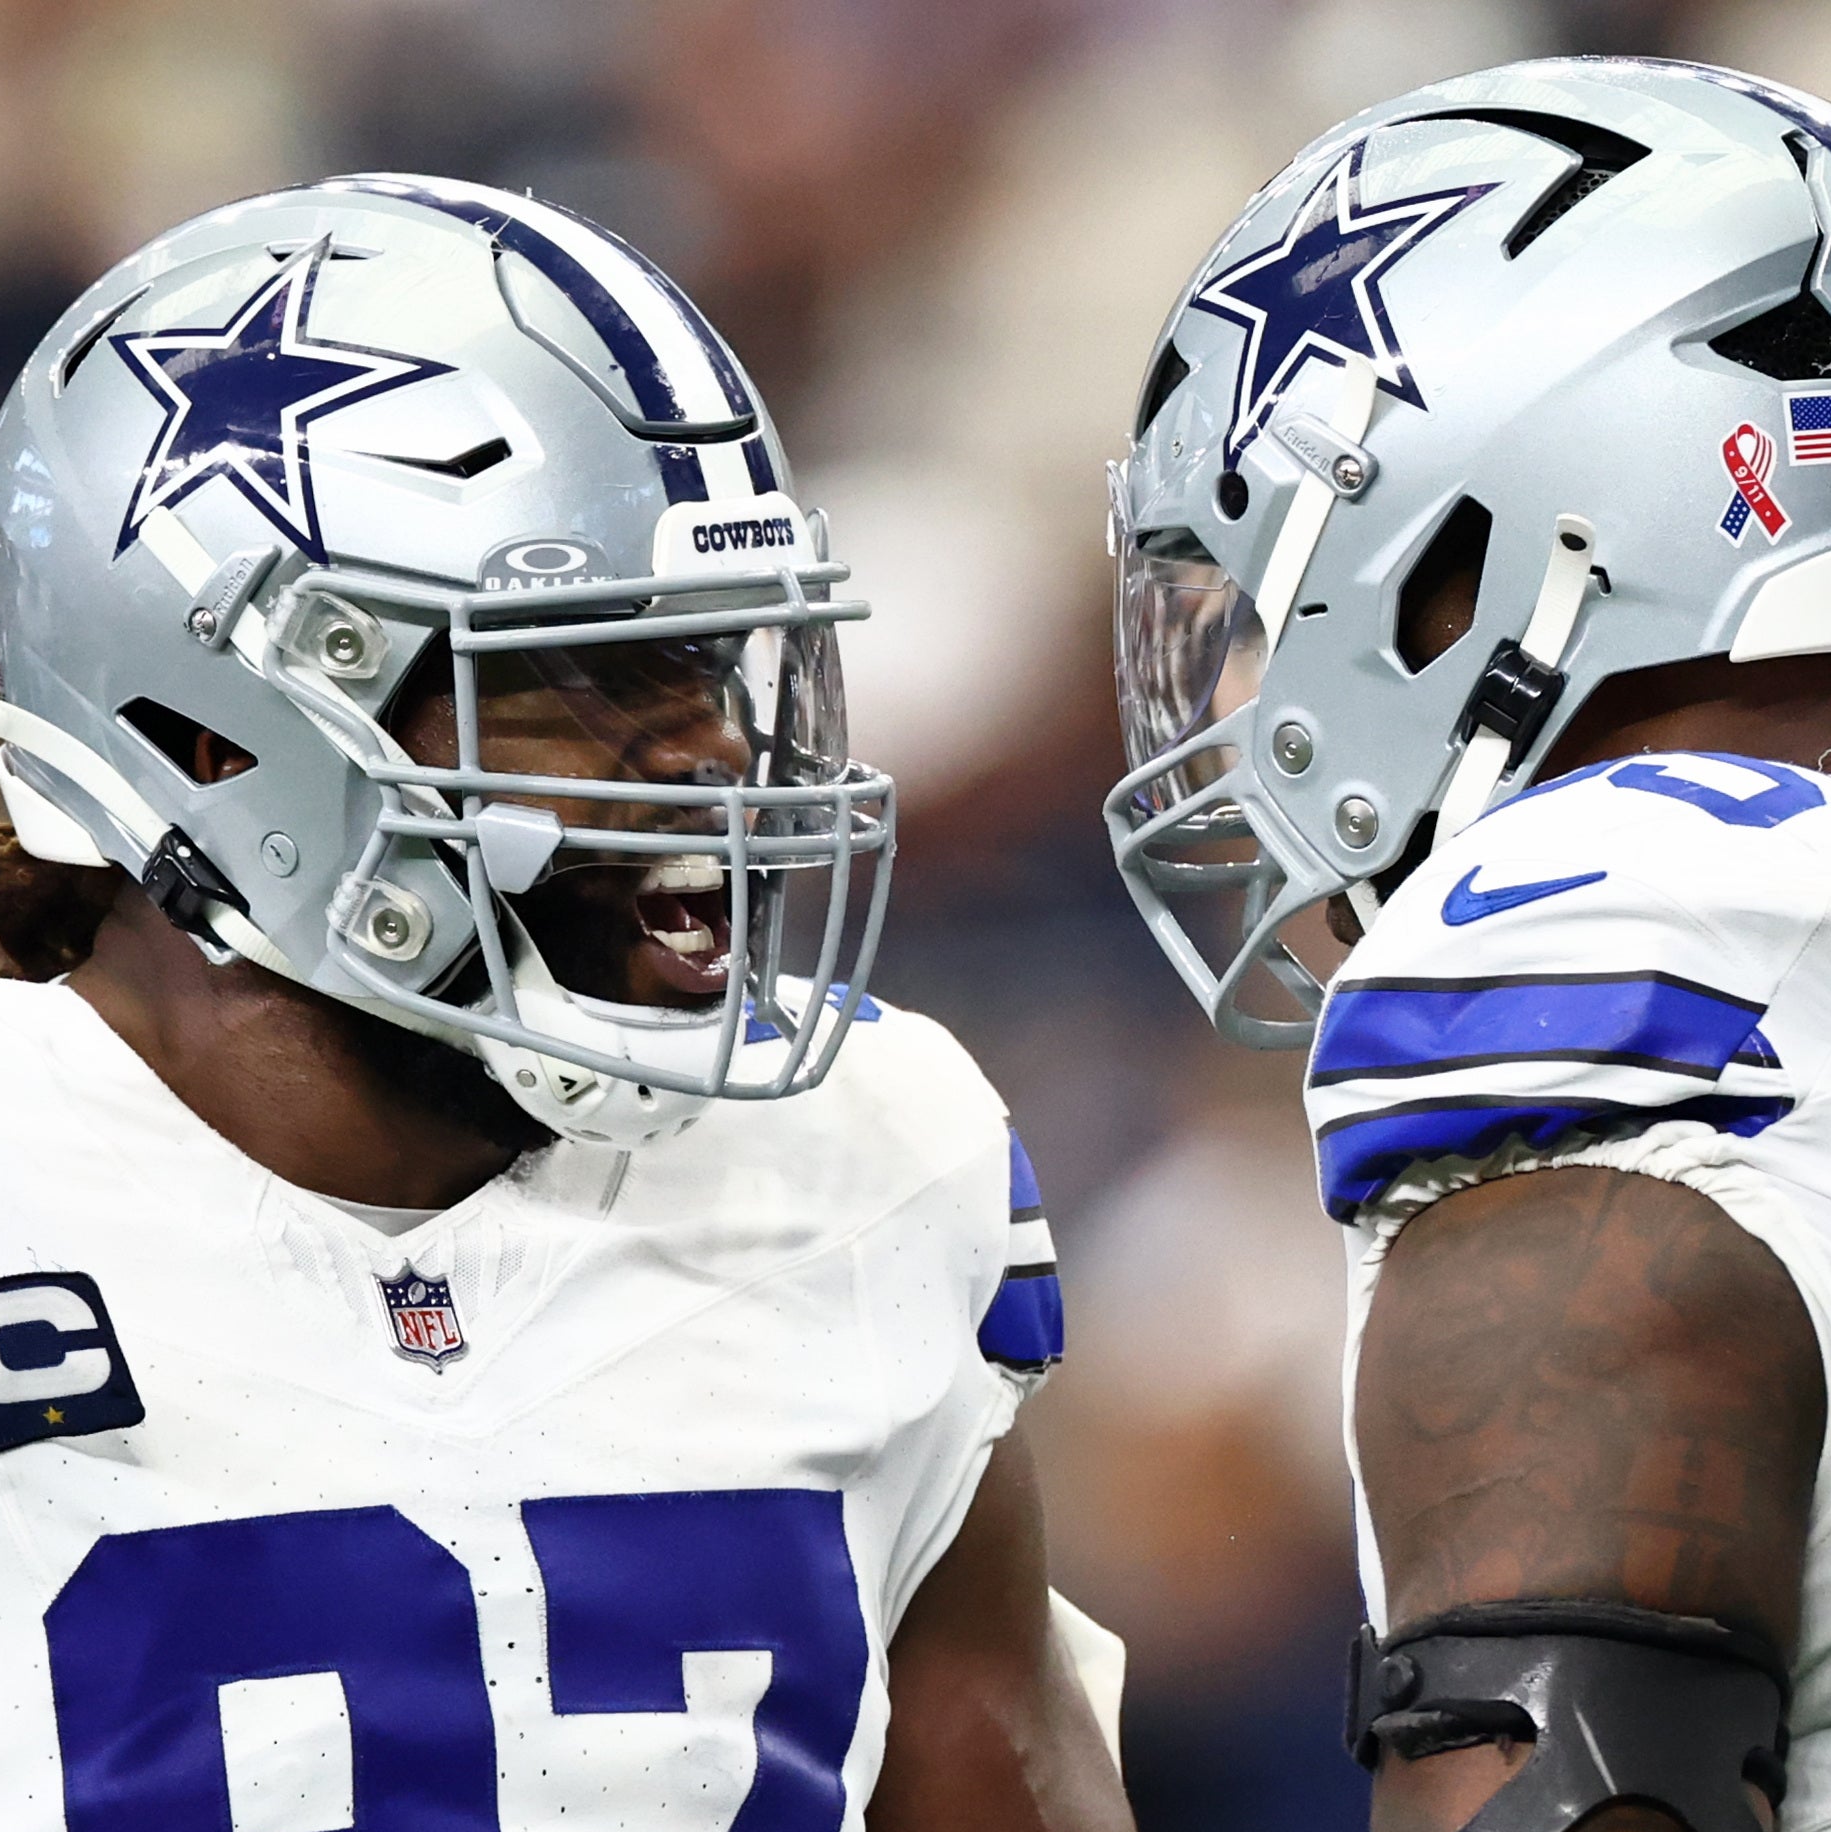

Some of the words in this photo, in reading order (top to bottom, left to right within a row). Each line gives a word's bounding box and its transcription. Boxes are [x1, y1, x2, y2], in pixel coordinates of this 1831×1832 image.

[1734, 466, 1765, 503] 9/11
[692, 517, 794, 553] COWBOYS
[397, 1310, 458, 1350] NFL
